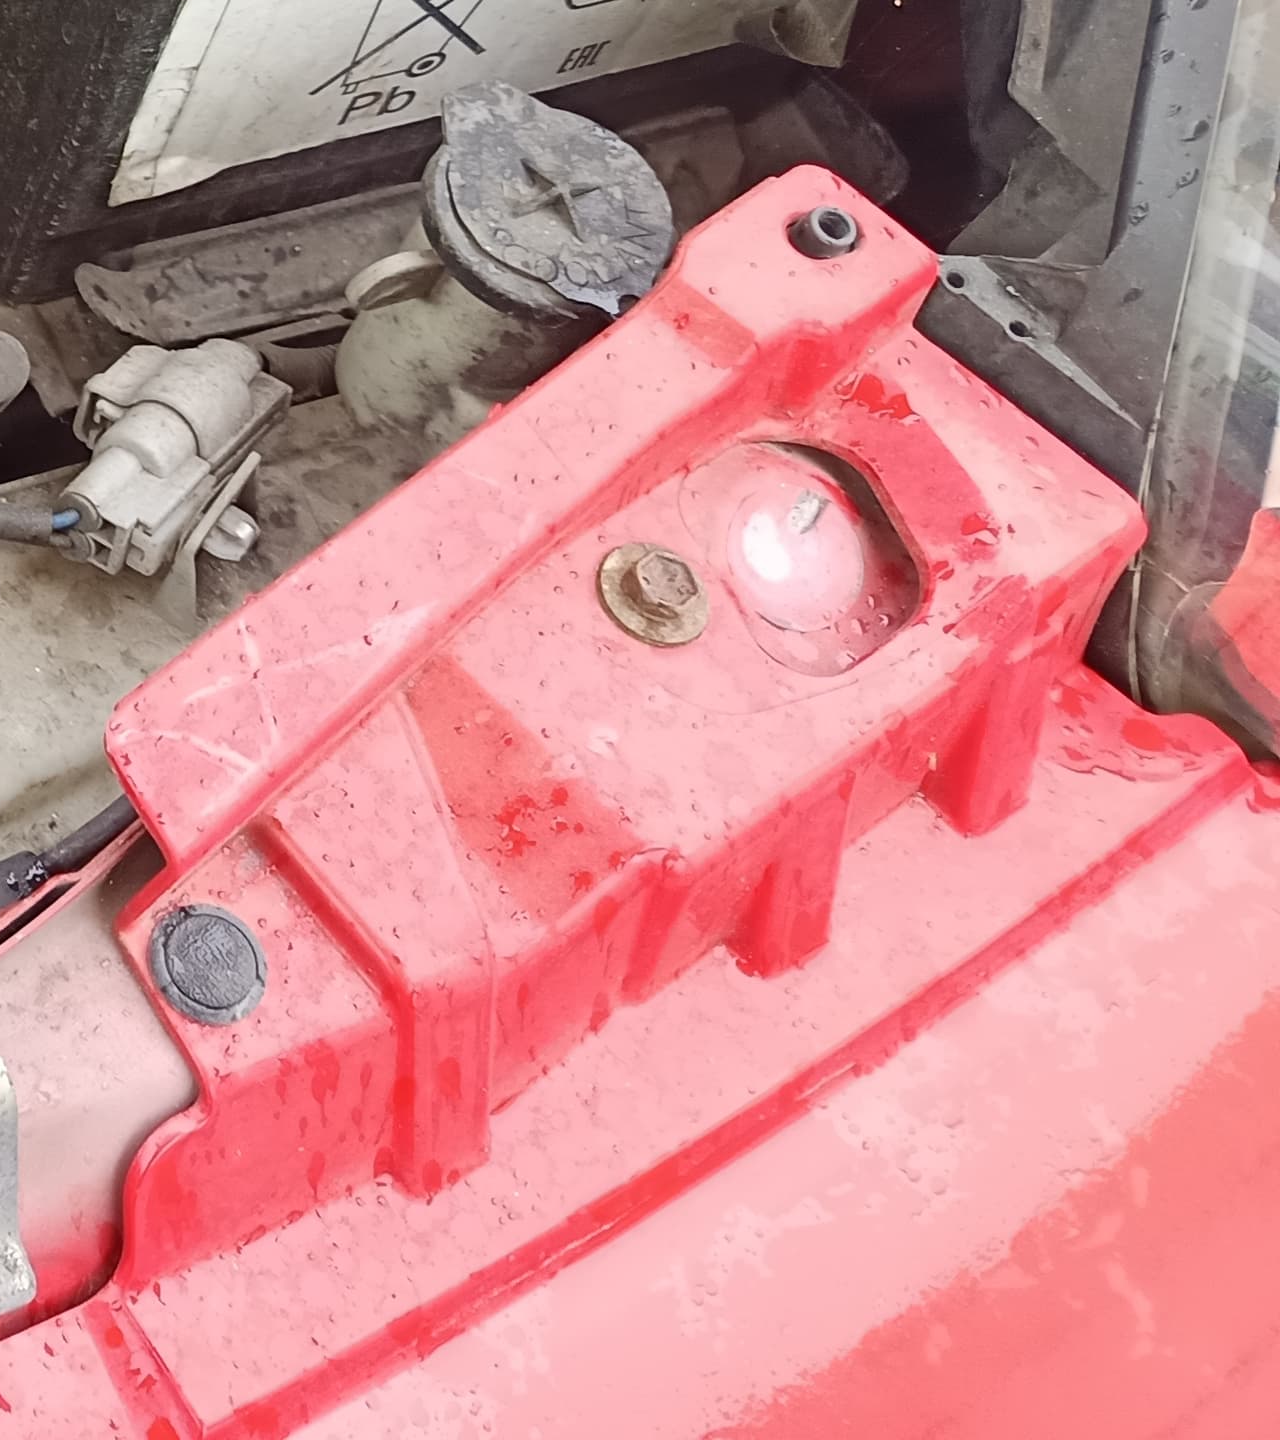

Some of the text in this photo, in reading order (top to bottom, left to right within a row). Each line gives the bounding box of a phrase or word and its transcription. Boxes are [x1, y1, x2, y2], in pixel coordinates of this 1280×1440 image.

[555, 39, 613, 75] EAC
[336, 85, 417, 126] Pb
[501, 198, 657, 288] COOLANT
